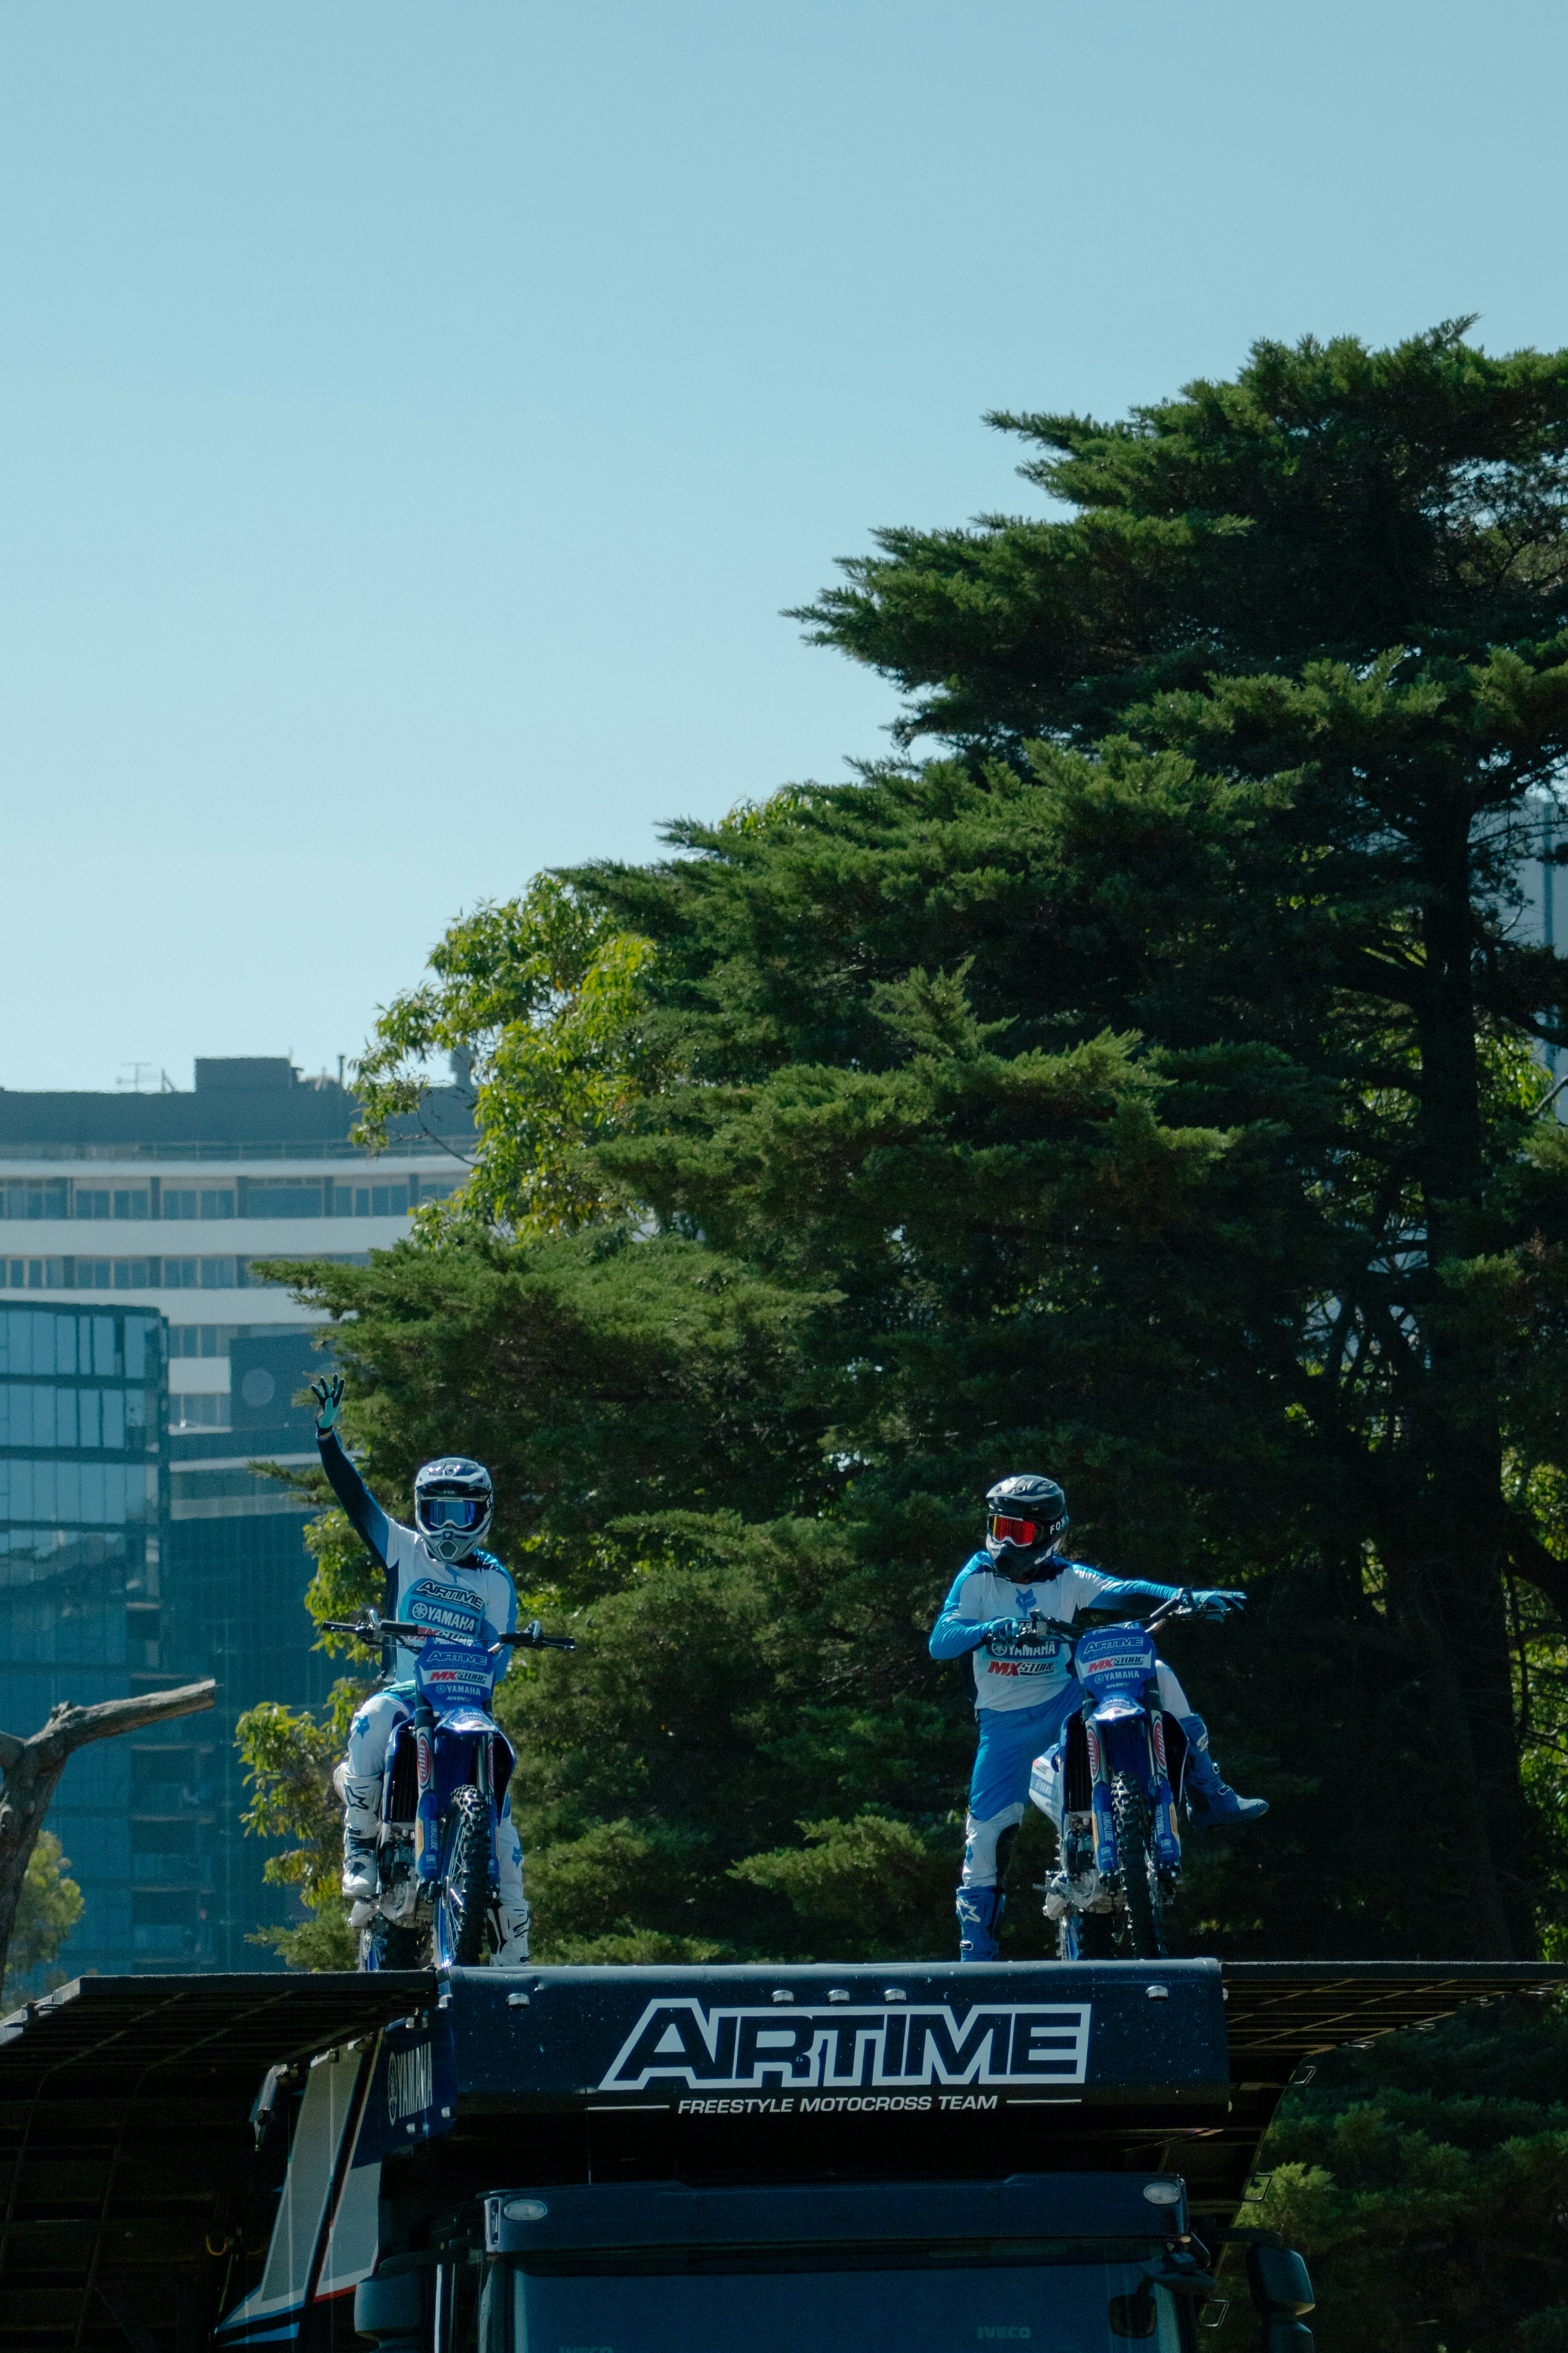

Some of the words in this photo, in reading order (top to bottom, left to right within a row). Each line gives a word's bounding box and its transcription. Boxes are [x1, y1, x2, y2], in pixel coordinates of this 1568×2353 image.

[1050, 1516, 1065, 1535] FOX
[416, 1580, 484, 1610] AIRTIME
[428, 1607, 475, 1631] YAMAHA
[1083, 1637, 1143, 1655] AIRTIME
[426, 1650, 488, 1666] AIRTIME
[1104, 1671, 1140, 1681] YAMAHA
[447, 1685, 481, 1696] YAMAHA
[598, 1998, 1092, 2090] AIRTIME
[398, 2041, 433, 2119] YAMAHA
[677, 2099, 794, 2114] FREESTYLE
[799, 2096, 932, 2113] MOTOCROSS
[938, 2095, 998, 2111] TEAM
[978, 2327, 1032, 2339] IVECO
